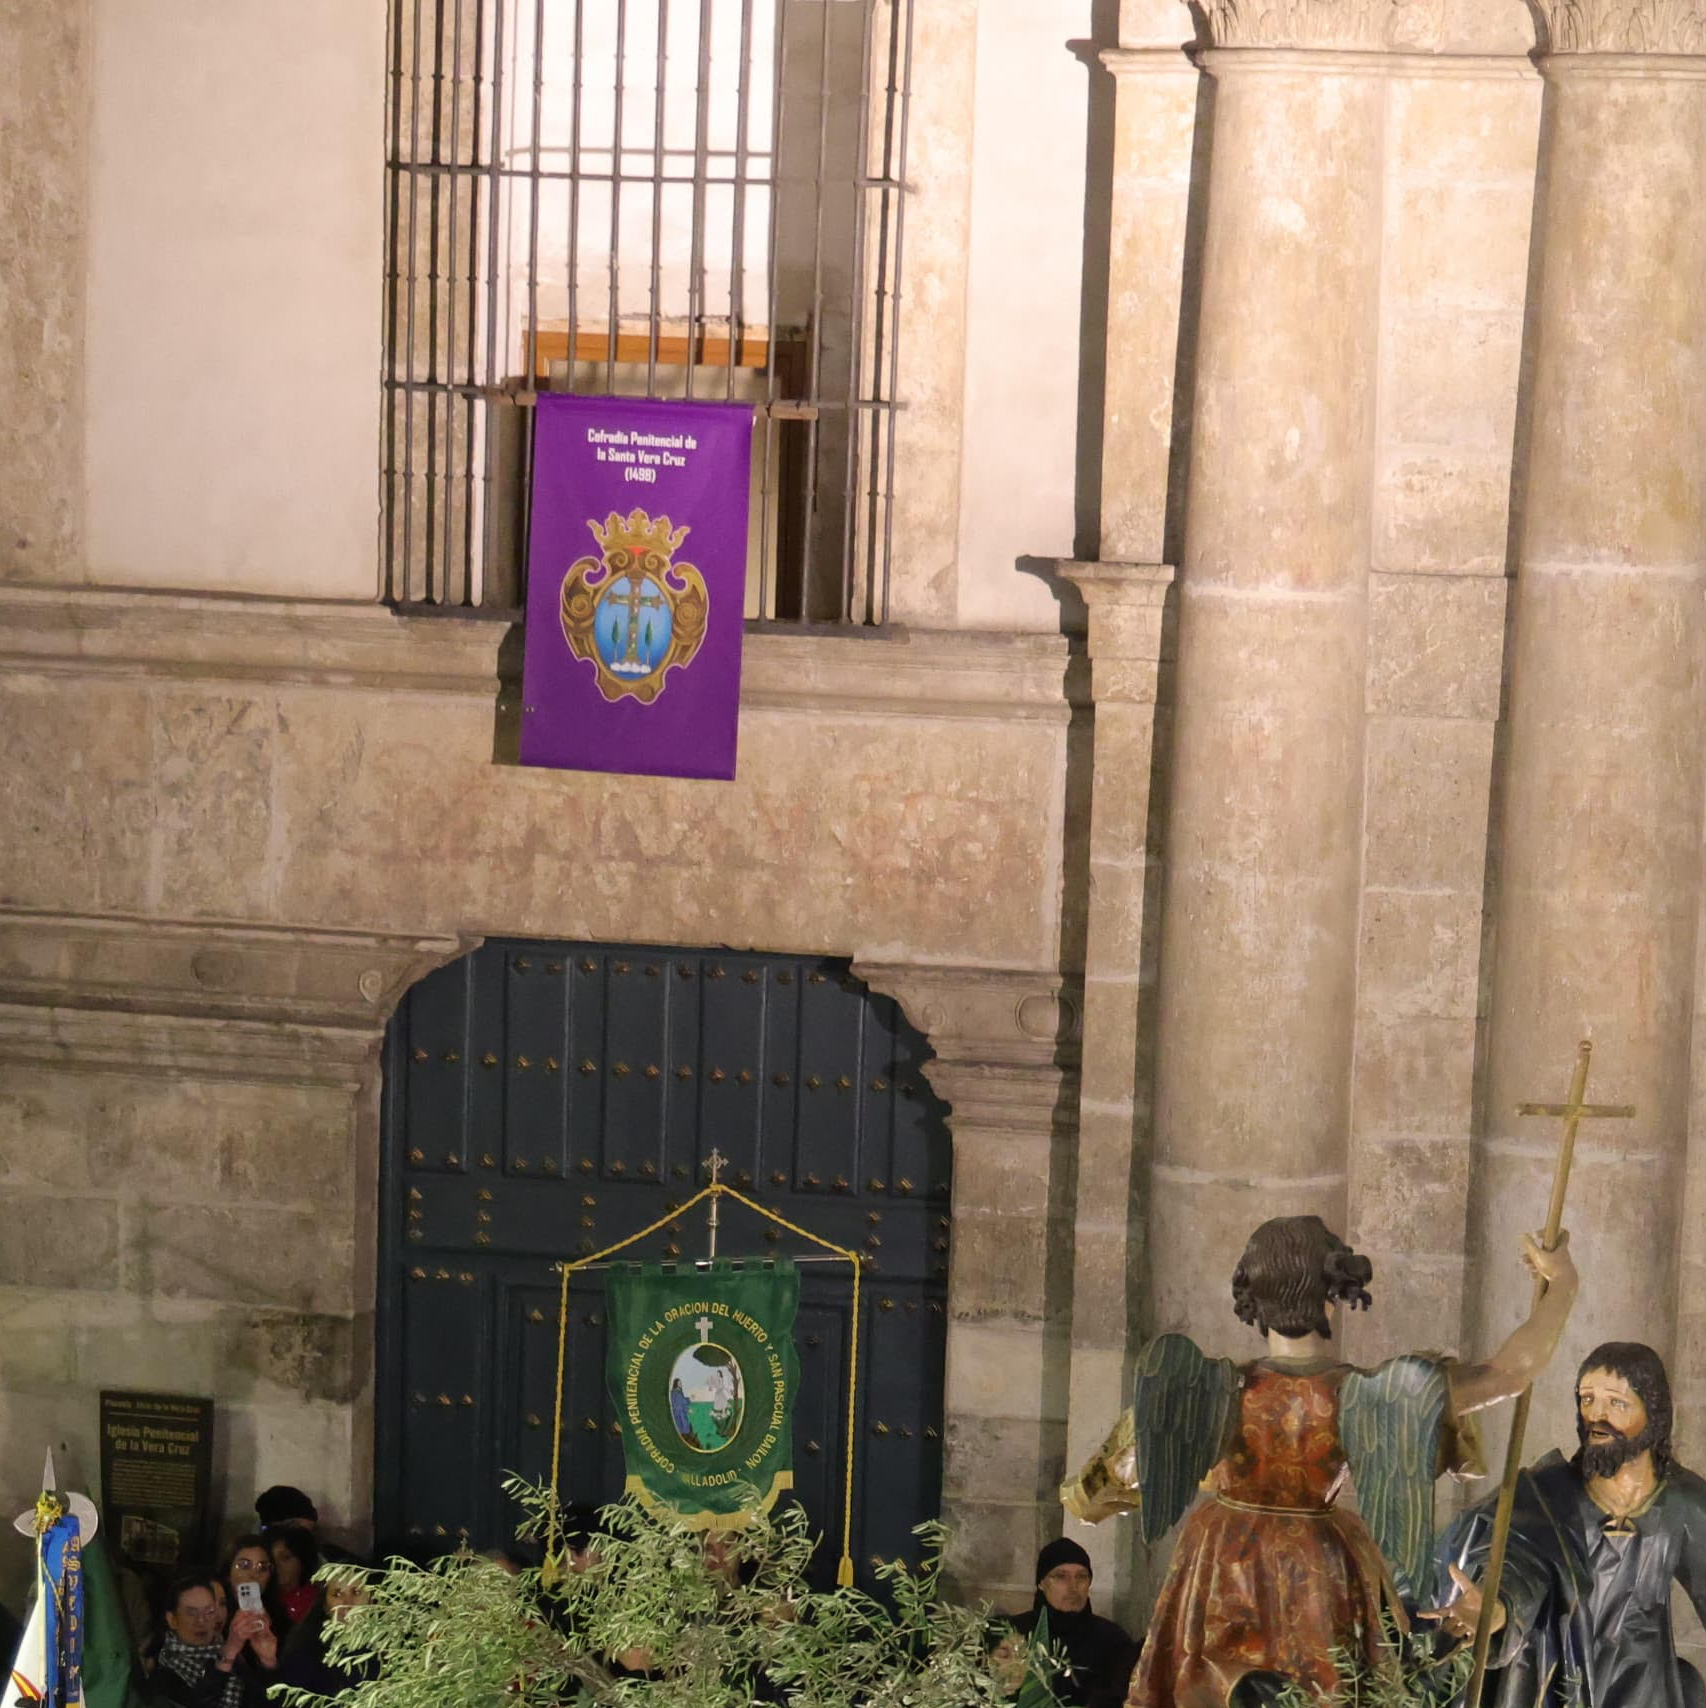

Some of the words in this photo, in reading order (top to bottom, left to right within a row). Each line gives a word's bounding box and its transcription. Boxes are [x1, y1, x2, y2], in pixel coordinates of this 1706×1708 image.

[630, 431, 683, 448] Penitencial
[684, 434, 697, 450] de
[596, 447, 606, 461] la
[608, 447, 635, 463] Santa
[637, 449, 661, 465] Vera
[662, 451, 686, 467] Cruz
[624, 467, 656, 483] (1498)
[664, 1302, 709, 1322] ORACION
[711, 1302, 730, 1317] DEL
[648, 1320, 666, 1336] LA
[732, 1309, 768, 1343] HUERTO
[638, 1333, 654, 1350] DE
[764, 1343, 773, 1352] Y
[768, 1353, 784, 1378] SAN
[625, 1352, 646, 1425] PENITENCIAL
[769, 1380, 785, 1430] PASCUAL
[168, 1443, 190, 1455] Cruz
[745, 1433, 776, 1469] BAILON
